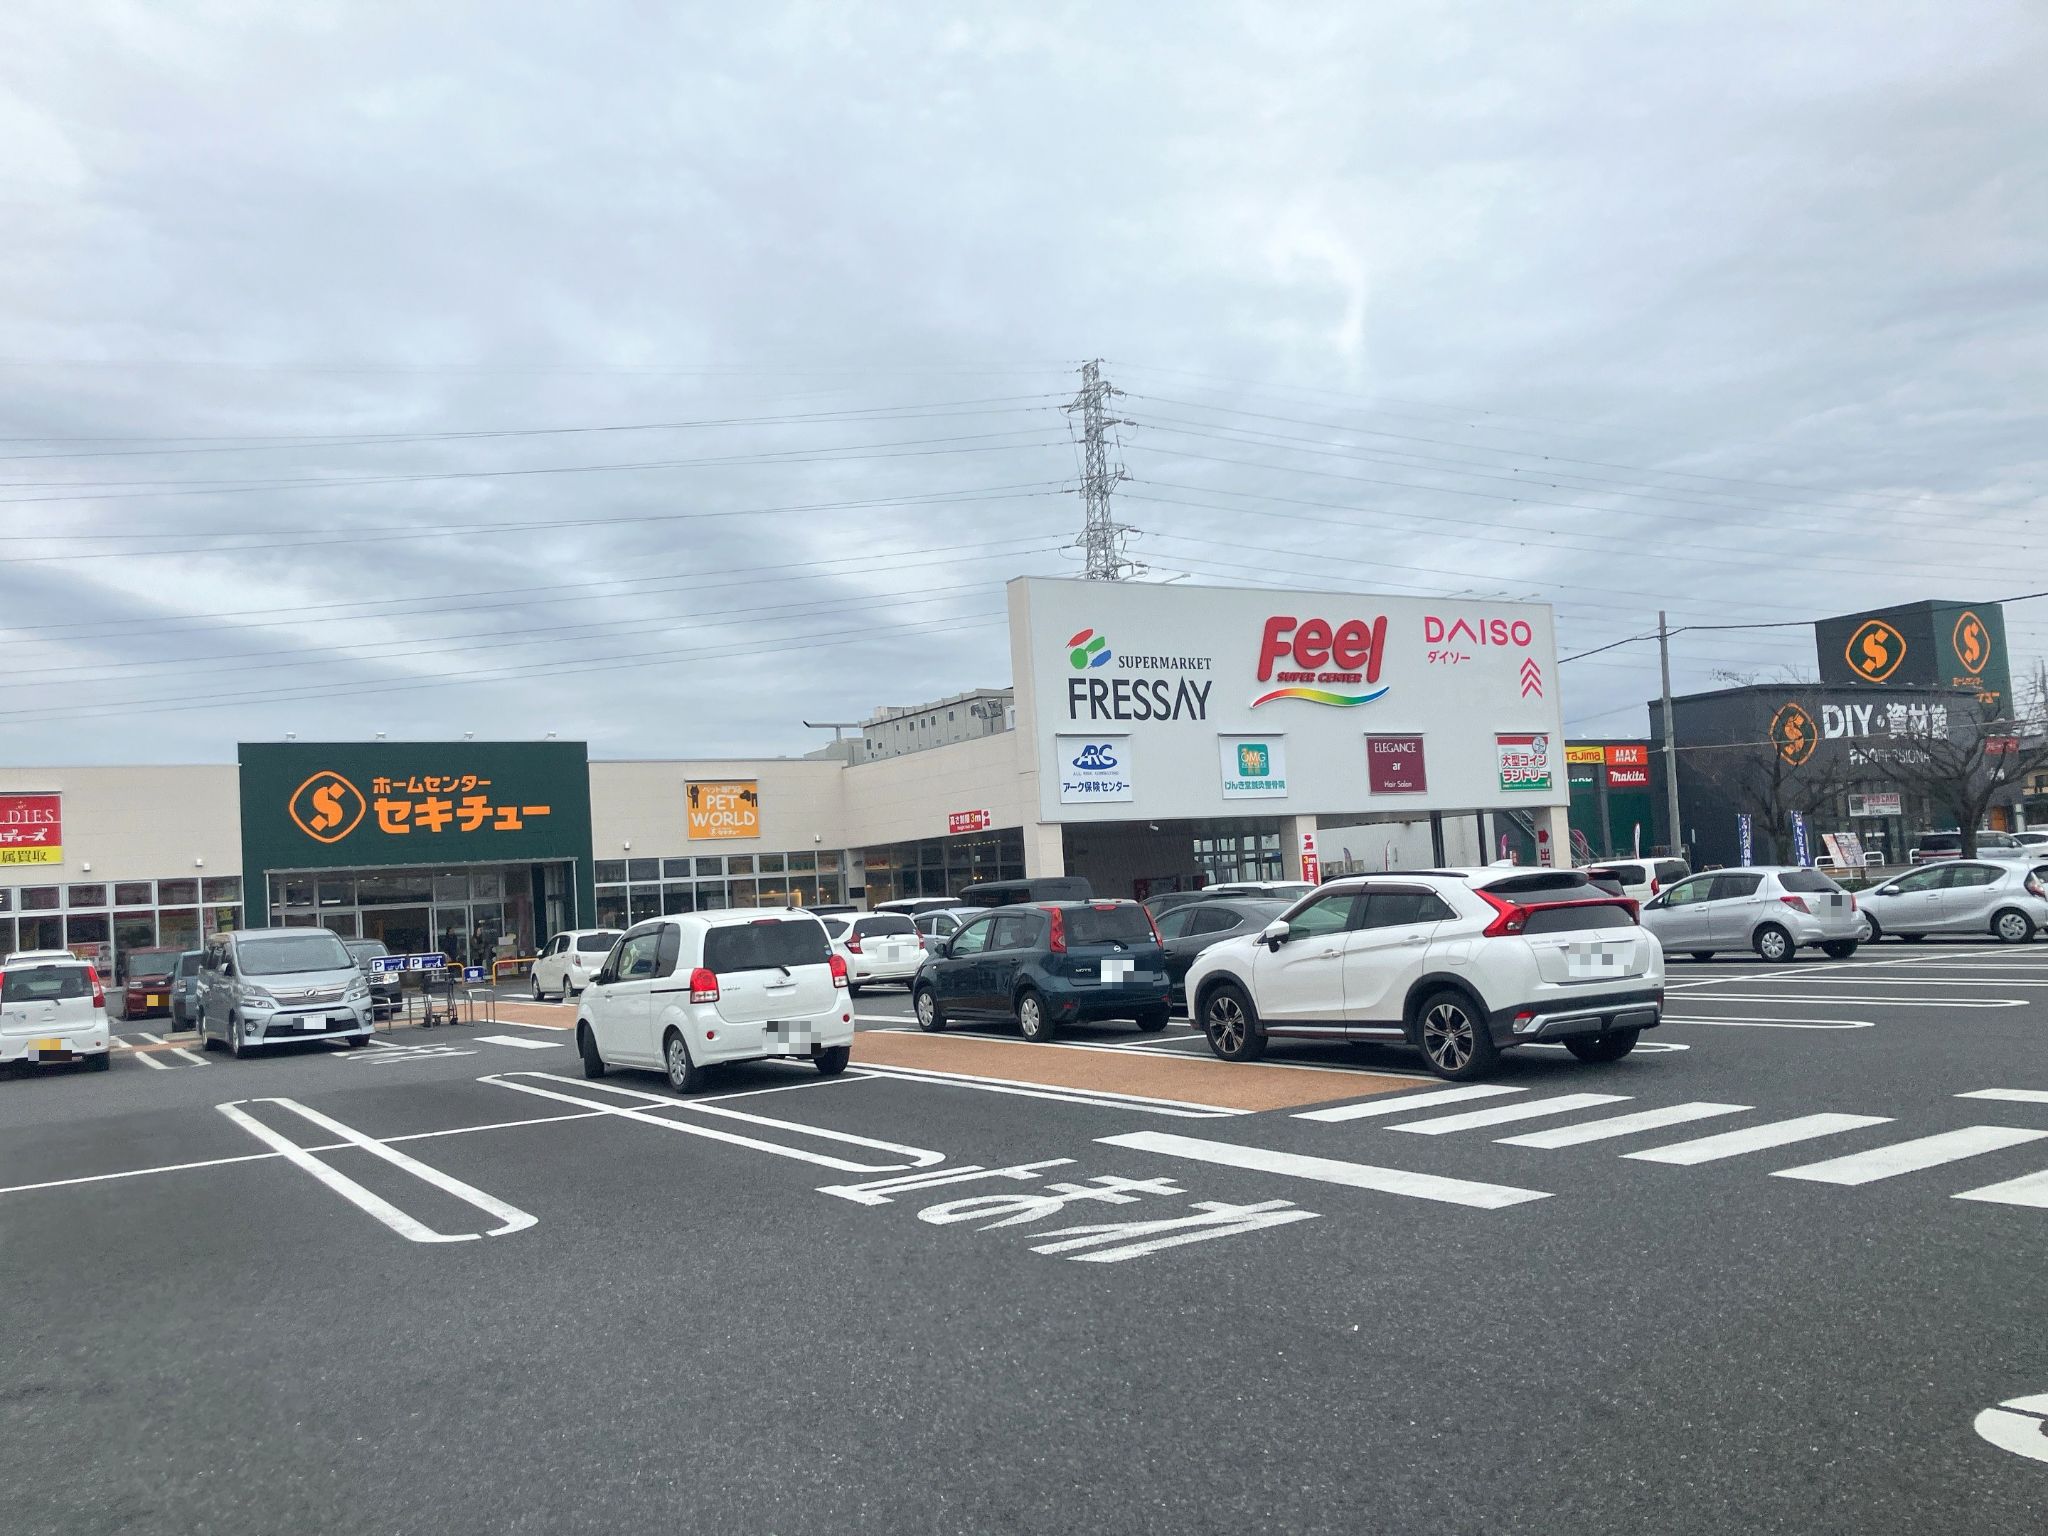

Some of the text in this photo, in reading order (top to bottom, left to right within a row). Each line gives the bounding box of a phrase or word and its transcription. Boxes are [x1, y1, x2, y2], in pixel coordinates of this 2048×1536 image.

[1424, 616, 1532, 647] DAISO
[1257, 615, 1388, 683] Feel
[1118, 655, 1212, 670] SUPERMARKET
[1428, 651, 1471, 664] ダイソー
[1068, 676, 1213, 721] FRESSAY
[1076, 744, 1114, 766] ARC
[1374, 742, 1416, 753] ELEGANCE
[1502, 754, 1547, 767] 大型コイン
[1615, 749, 1637, 762] MAX
[1503, 769, 1548, 781] ランドリー
[373, 775, 492, 794] ホームセンター
[1063, 781, 1130, 793] アーク保険センター
[1384, 780, 1396, 788] Hair
[706, 794, 739, 810] PET
[0, 809, 54, 824] DIES
[374, 796, 551, 834] セキチュー
[691, 810, 756, 827] WORLD
[815, 1158, 1323, 1263] 止まれ
